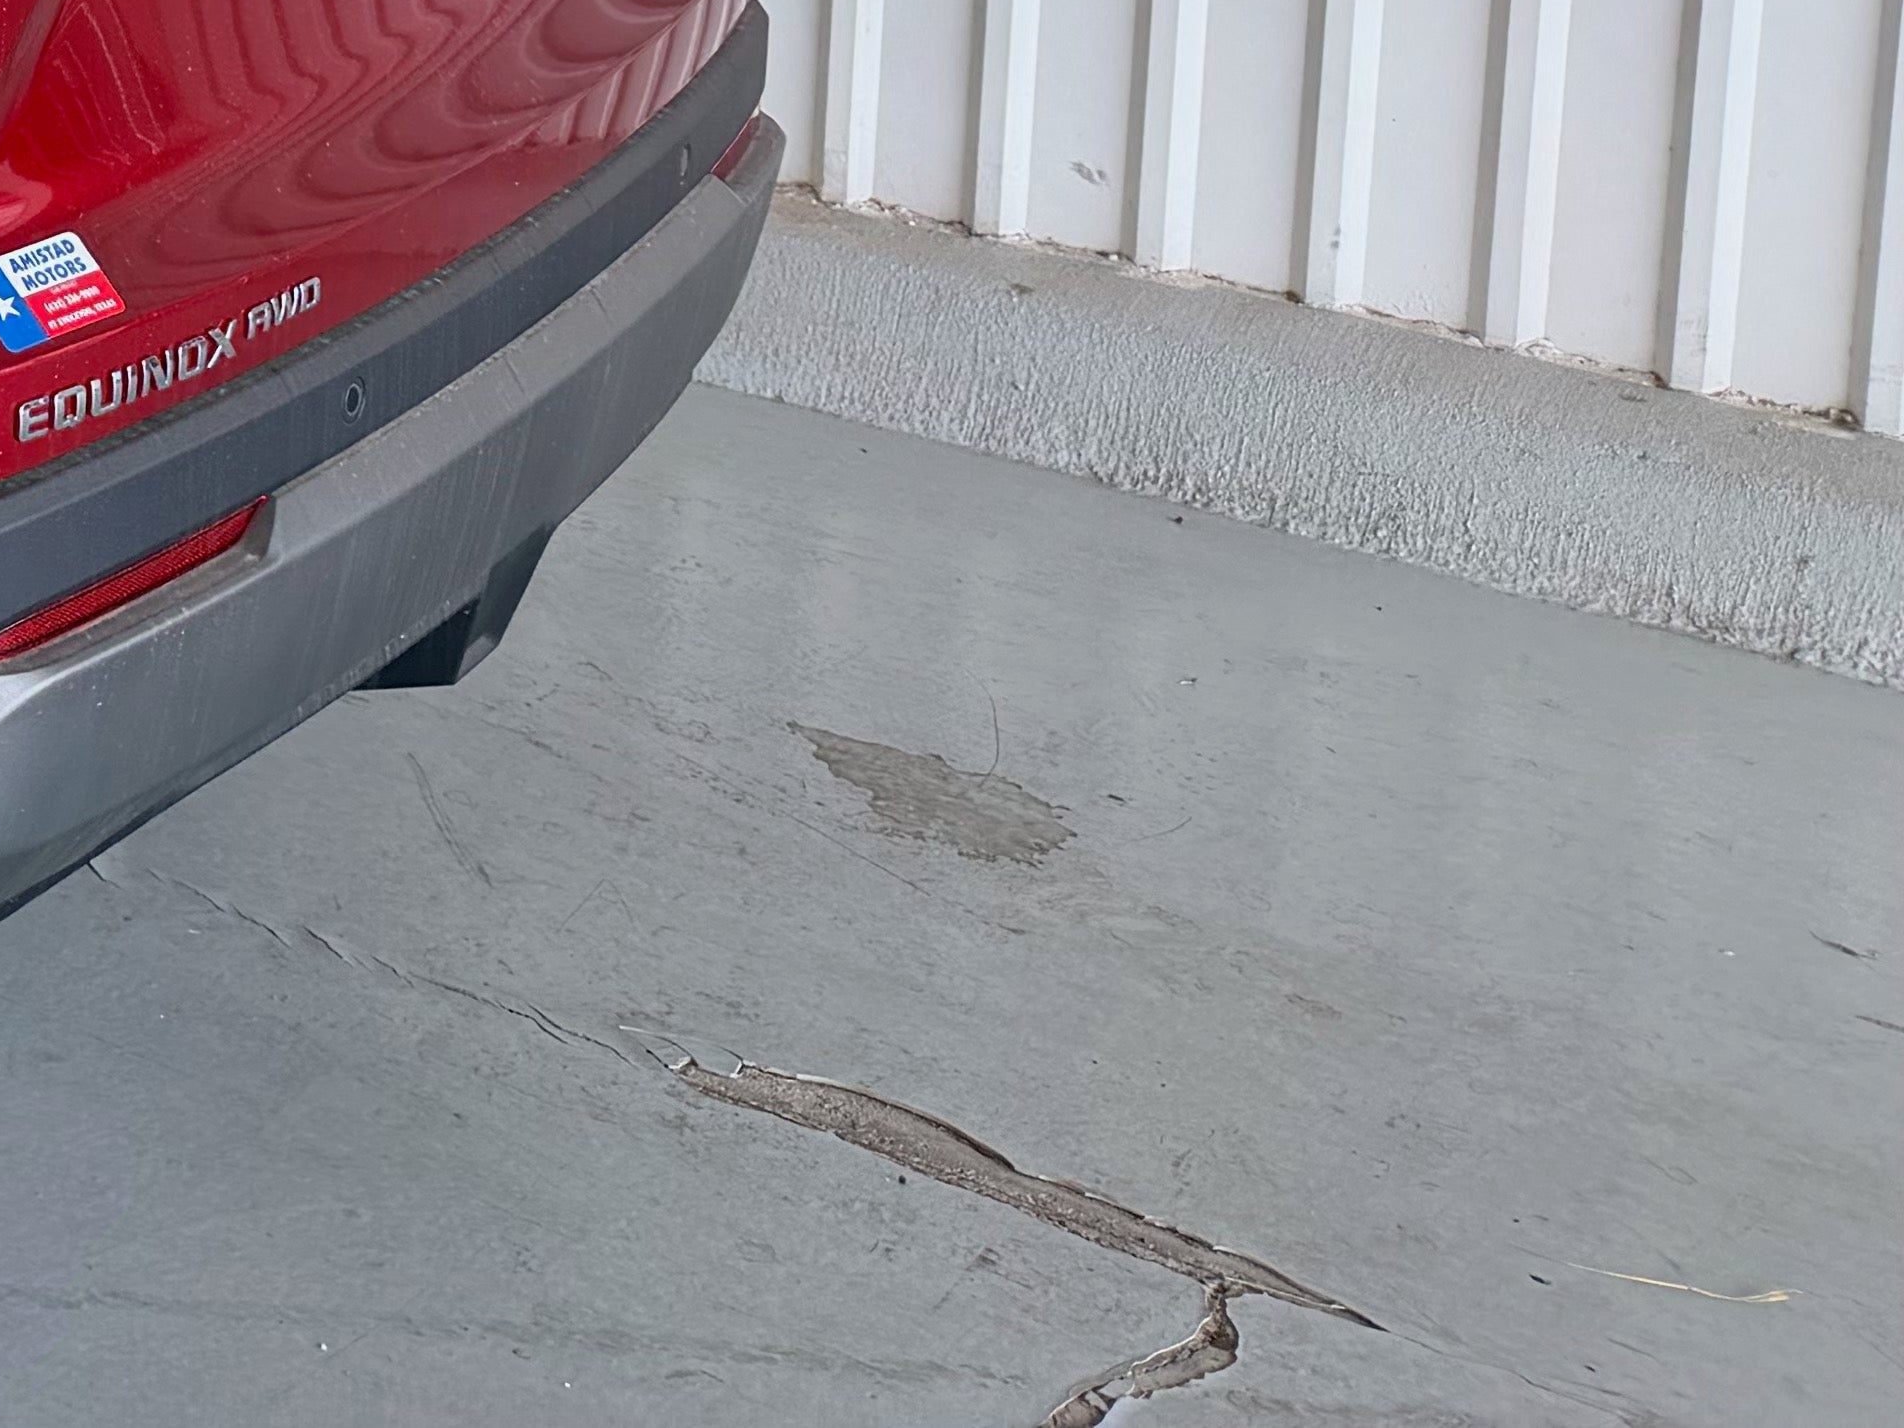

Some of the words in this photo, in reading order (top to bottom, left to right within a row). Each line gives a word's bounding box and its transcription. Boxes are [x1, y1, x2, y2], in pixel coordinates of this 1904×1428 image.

[8, 239, 76, 274] AMISTAD
[21, 256, 87, 291] MOTORS
[18, 319, 238, 443] EQUINOX
[247, 276, 322, 340] AWD
